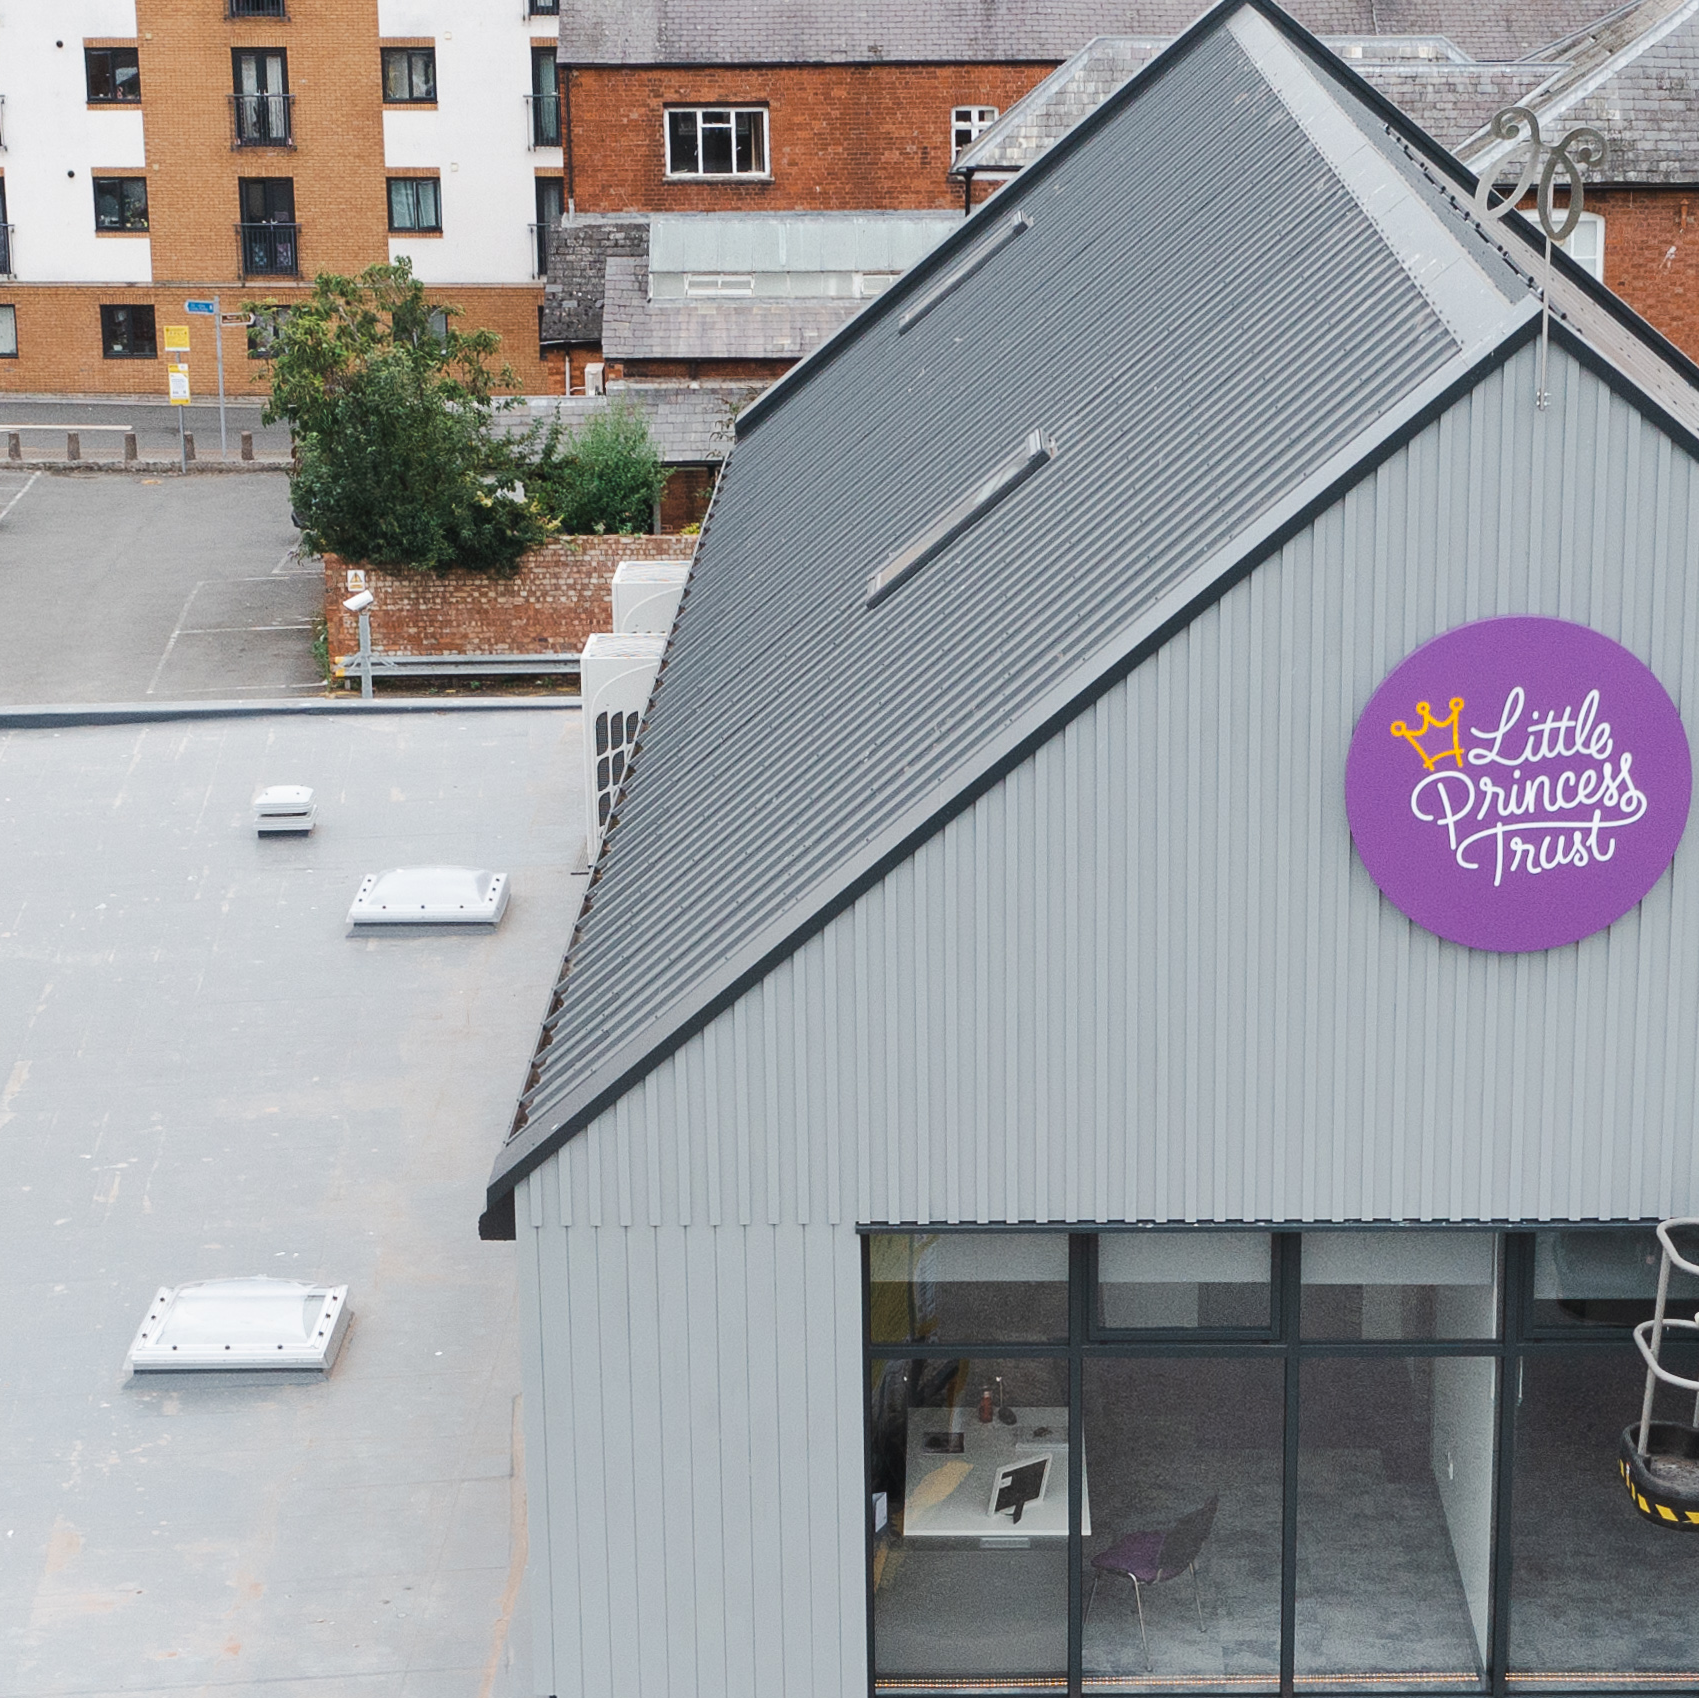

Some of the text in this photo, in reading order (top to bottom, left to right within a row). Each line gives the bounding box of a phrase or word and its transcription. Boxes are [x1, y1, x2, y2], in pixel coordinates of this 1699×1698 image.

[1468, 686, 1613, 766] Little
[1411, 752, 1647, 850] Princess
[1456, 808, 1615, 886] Trust
